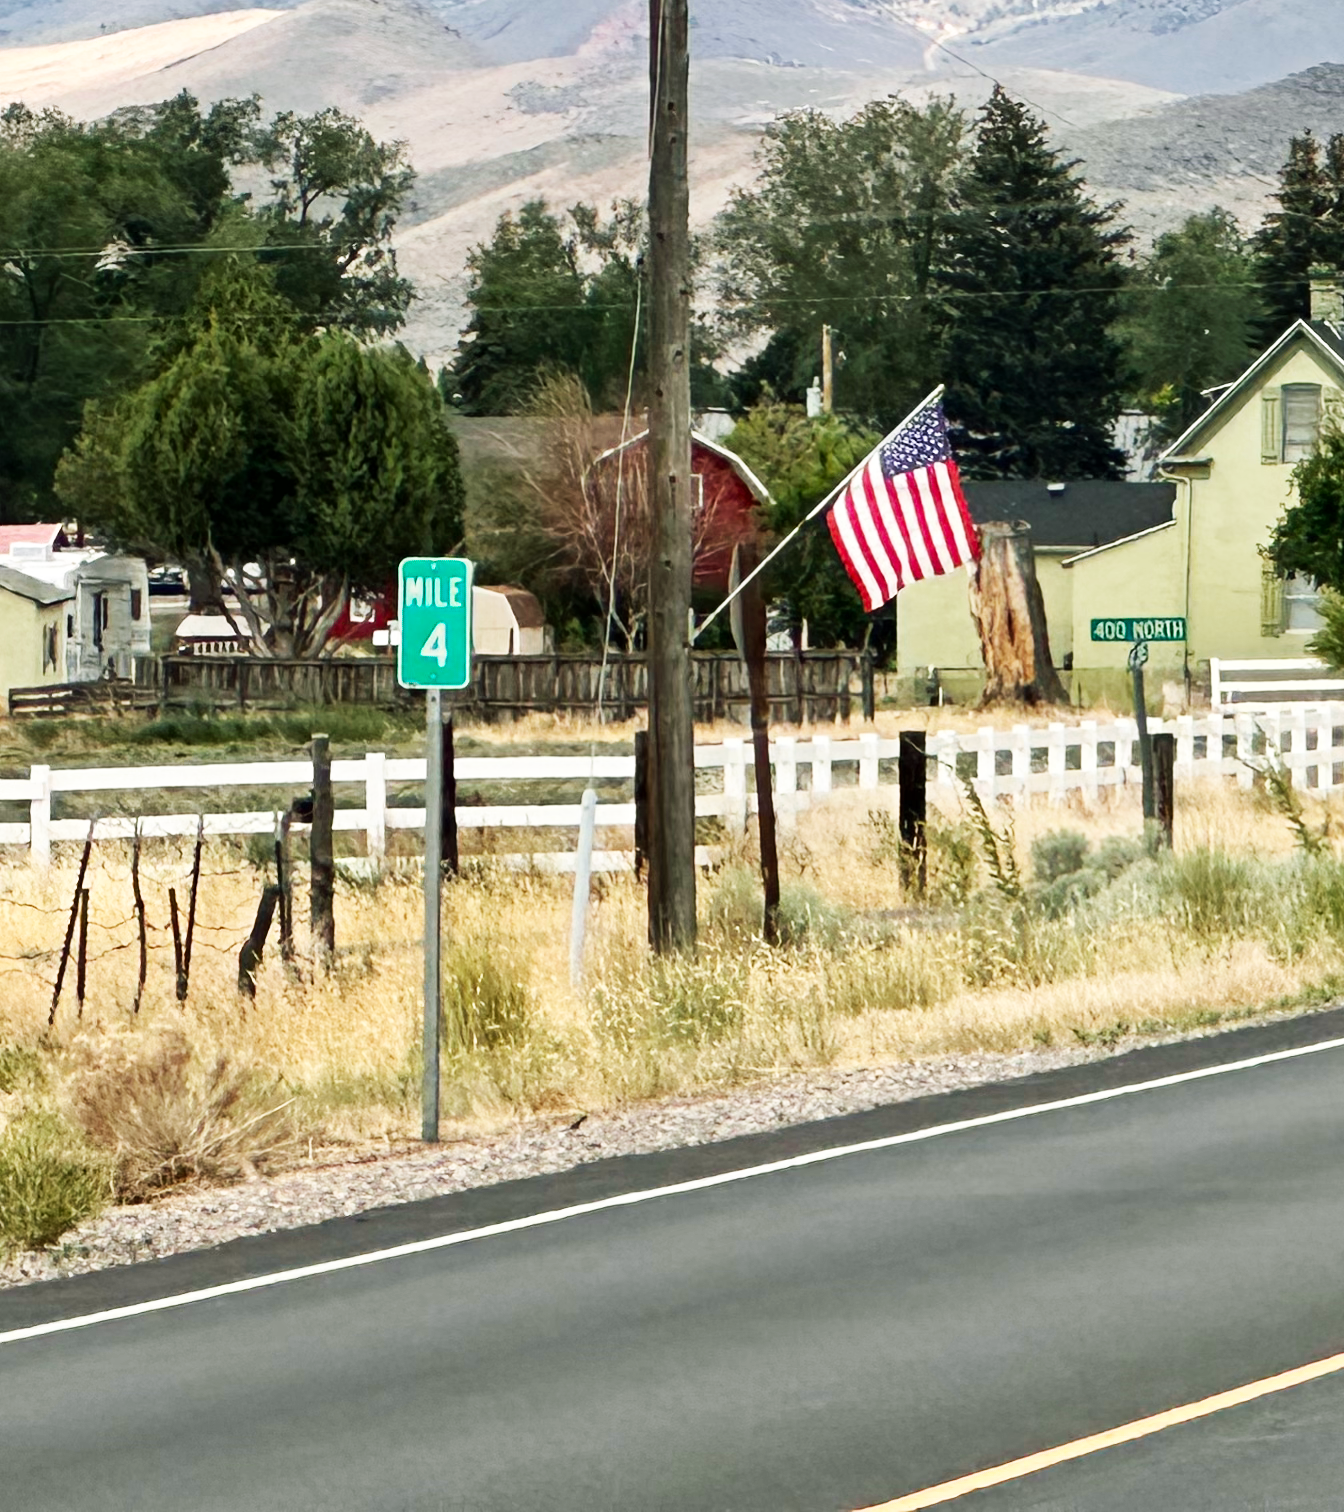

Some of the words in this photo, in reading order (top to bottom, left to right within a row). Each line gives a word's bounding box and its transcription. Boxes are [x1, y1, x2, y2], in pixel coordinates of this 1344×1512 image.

[405, 576, 462, 607] MILE
[1093, 621, 1126, 639] 400
[1133, 619, 1183, 639] NORTH
[420, 622, 448, 668] 4
